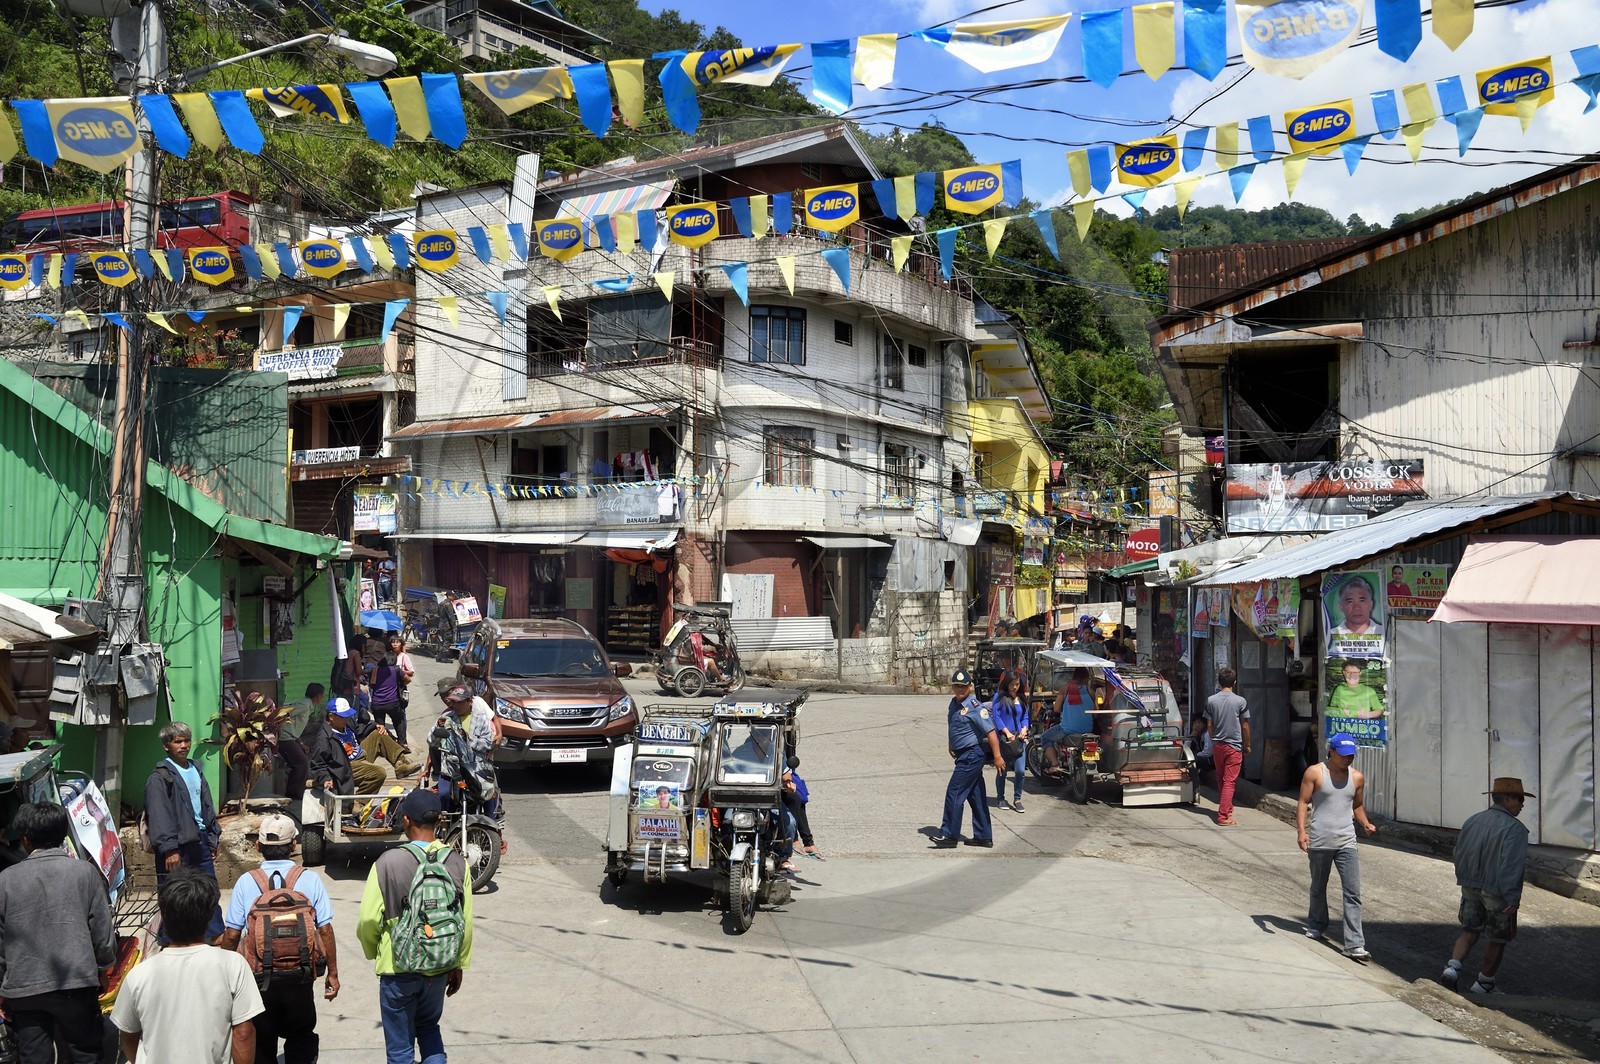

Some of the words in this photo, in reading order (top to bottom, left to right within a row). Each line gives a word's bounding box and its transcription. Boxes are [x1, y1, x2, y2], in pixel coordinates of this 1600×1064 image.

[1486, 72, 1543, 96] B-MEG
[1292, 114, 1344, 135] B-MEG
[1122, 149, 1170, 168] B-MEG
[951, 177, 994, 195] B-MEG
[810, 197, 851, 212] B-MEG
[673, 214, 711, 228] B-MEG
[543, 229, 577, 241] B-MEG
[419, 242, 453, 253] B-MEG
[305, 250, 338, 260] B-MEG
[97, 261, 126, 272] B-MEG
[195, 257, 226, 267] B-MEG
[277, 360, 310, 371] COFFEE
[1126, 540, 1160, 551] MOTO
[1329, 721, 1381, 735] JUMBO
